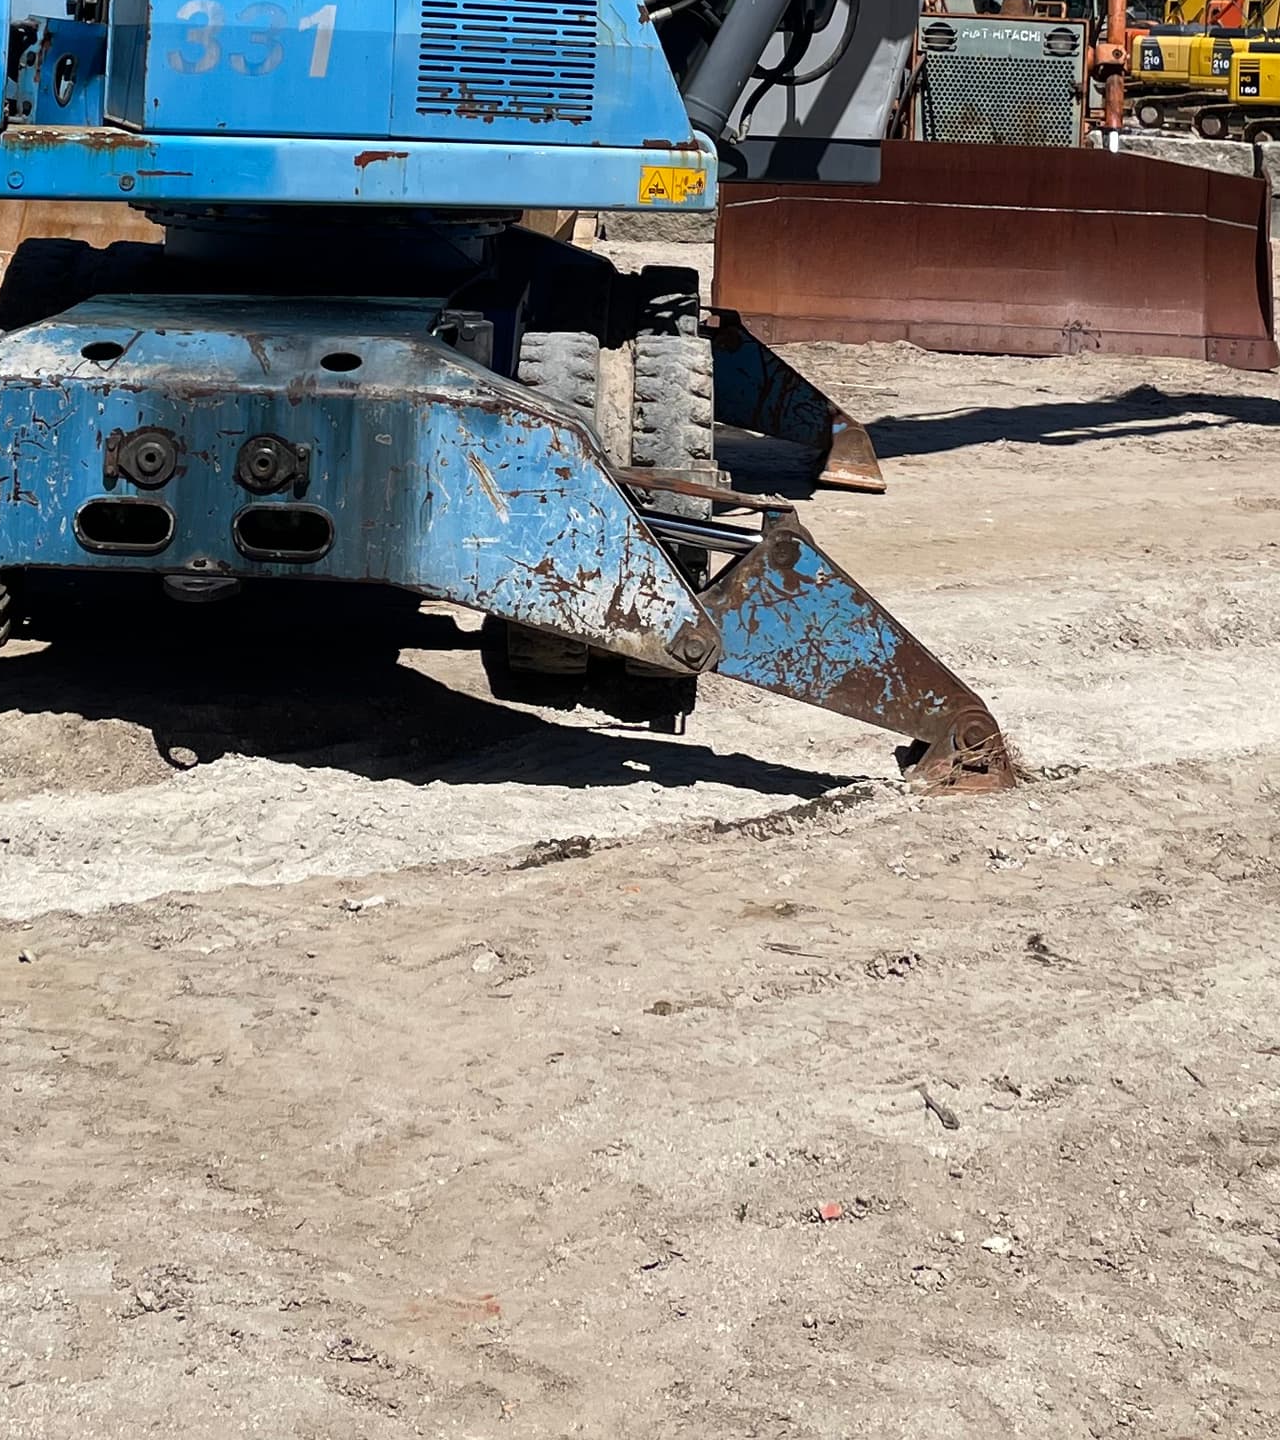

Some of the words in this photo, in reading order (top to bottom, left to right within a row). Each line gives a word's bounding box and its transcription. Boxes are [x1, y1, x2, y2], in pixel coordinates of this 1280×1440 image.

[167, 0, 337, 78] 331
[1143, 56, 1160, 66] 210
[1213, 60, 1230, 69] 210
